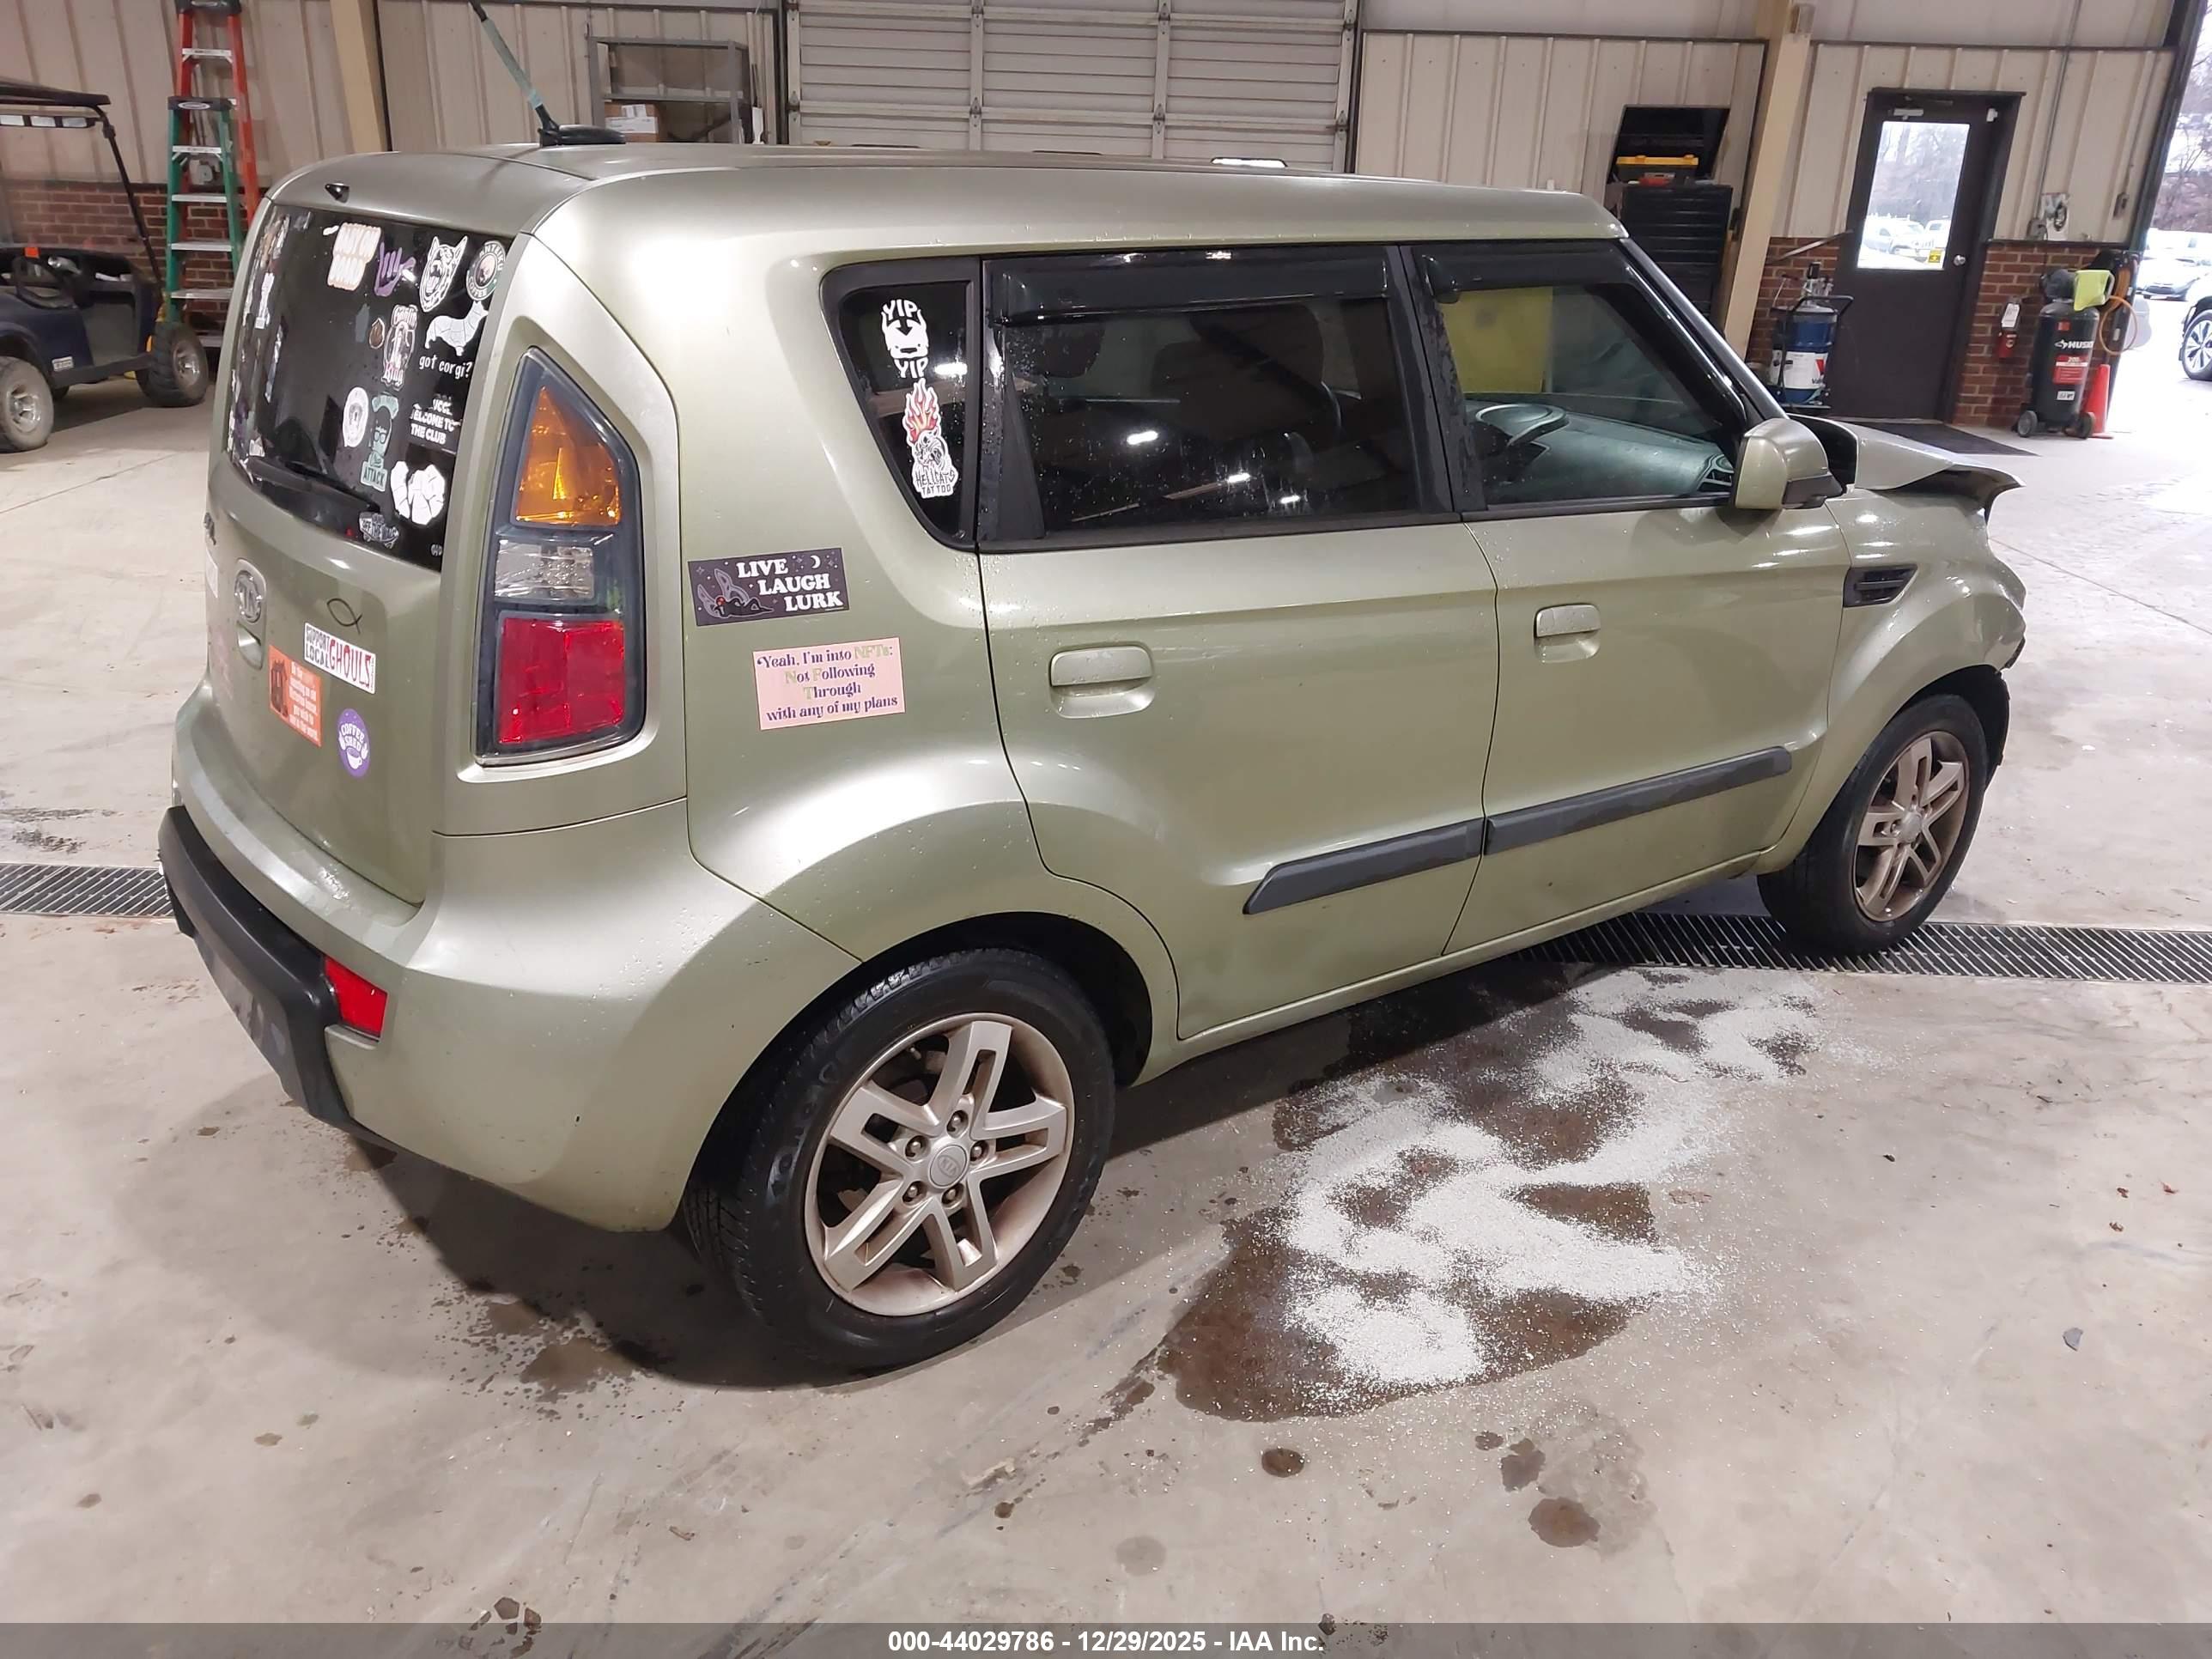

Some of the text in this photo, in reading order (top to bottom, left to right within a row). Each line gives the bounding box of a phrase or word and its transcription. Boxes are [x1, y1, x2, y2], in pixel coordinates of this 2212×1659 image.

[882, 299, 918, 321] YIP
[419, 355, 473, 380] got corgi?
[894, 356, 928, 379] YIP
[410, 423, 447, 445] THE CLUB
[363, 466, 385, 487] ATTACK
[915, 467, 956, 487] HELLCATS
[922, 483, 951, 495] TATTOO
[736, 558, 789, 578] LIVE
[757, 573, 831, 595] LAUGH
[784, 591, 844, 611] LURK
[306, 625, 330, 651] SUPPORT
[306, 642, 330, 669] LOCAL
[330, 639, 372, 689] GHOULS
[803, 651, 823, 665] I'm
[826, 649, 852, 662] into
[854, 644, 892, 659] NFTs:
[784, 663, 875, 684] Not Following
[803, 681, 861, 700] Through
[766, 696, 898, 720] with any of my plans
[341, 723, 365, 744] COFFEE
